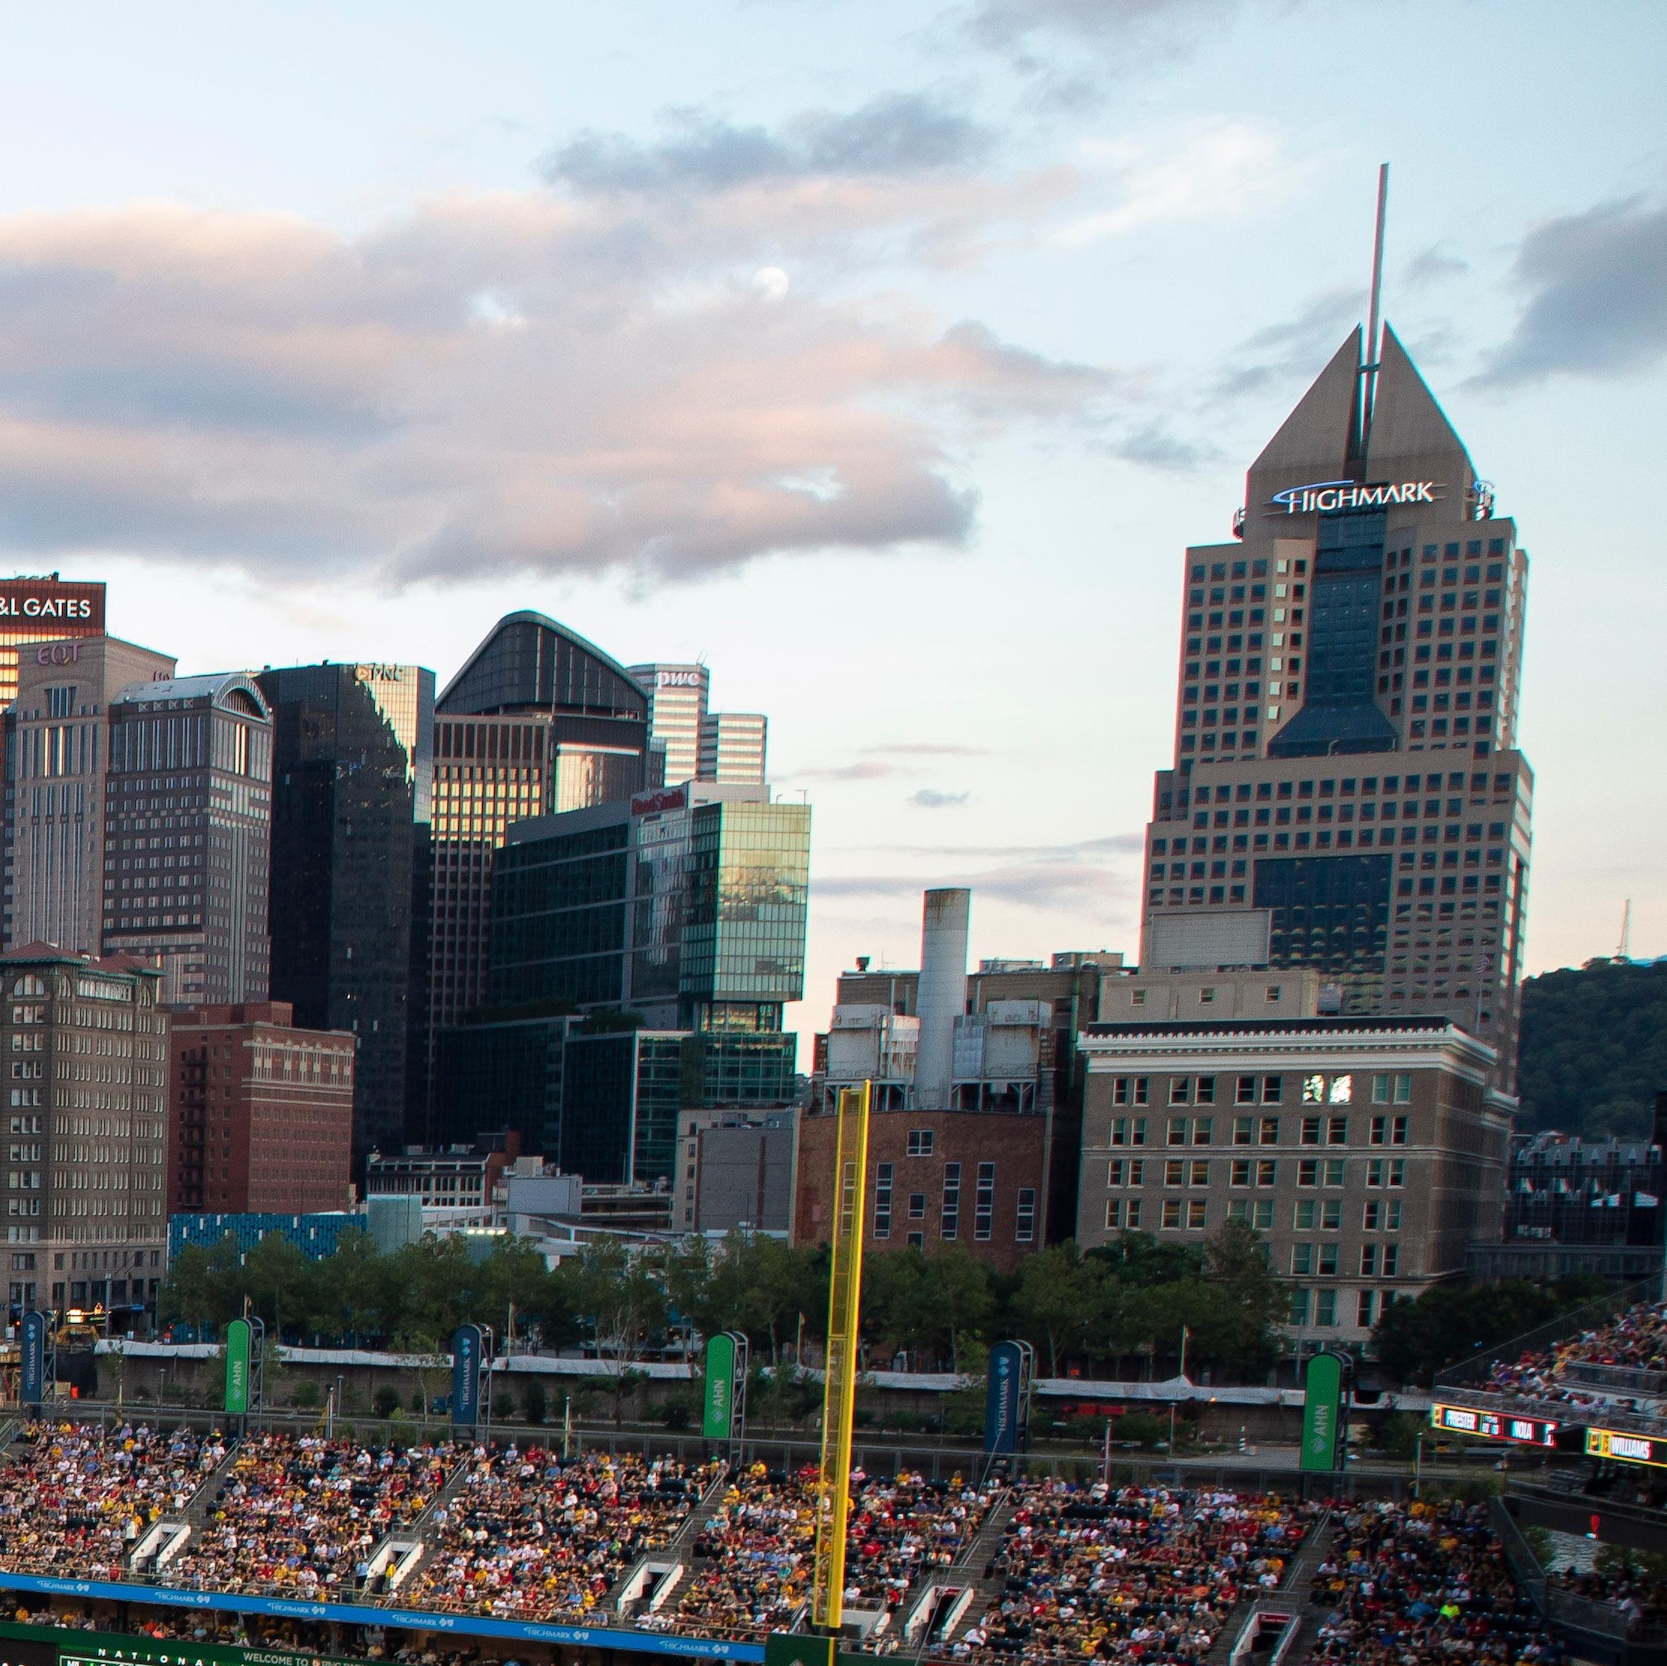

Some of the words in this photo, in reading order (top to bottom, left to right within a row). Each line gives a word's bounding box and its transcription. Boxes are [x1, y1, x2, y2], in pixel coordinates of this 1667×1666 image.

[1288, 481, 1433, 514] HIGHMARK
[24, 598, 91, 618] GATES
[37, 644, 83, 665] EQT
[232, 1361, 242, 1385] AHN
[715, 1380, 725, 1407] AHN
[1313, 1405, 1328, 1436] AHN
[1511, 1420, 1534, 1440] NOLA
[1610, 1436, 1651, 1460] WILLIAMS
[243, 1652, 293, 1666] WELCOME
[296, 1658, 309, 1666] TO
